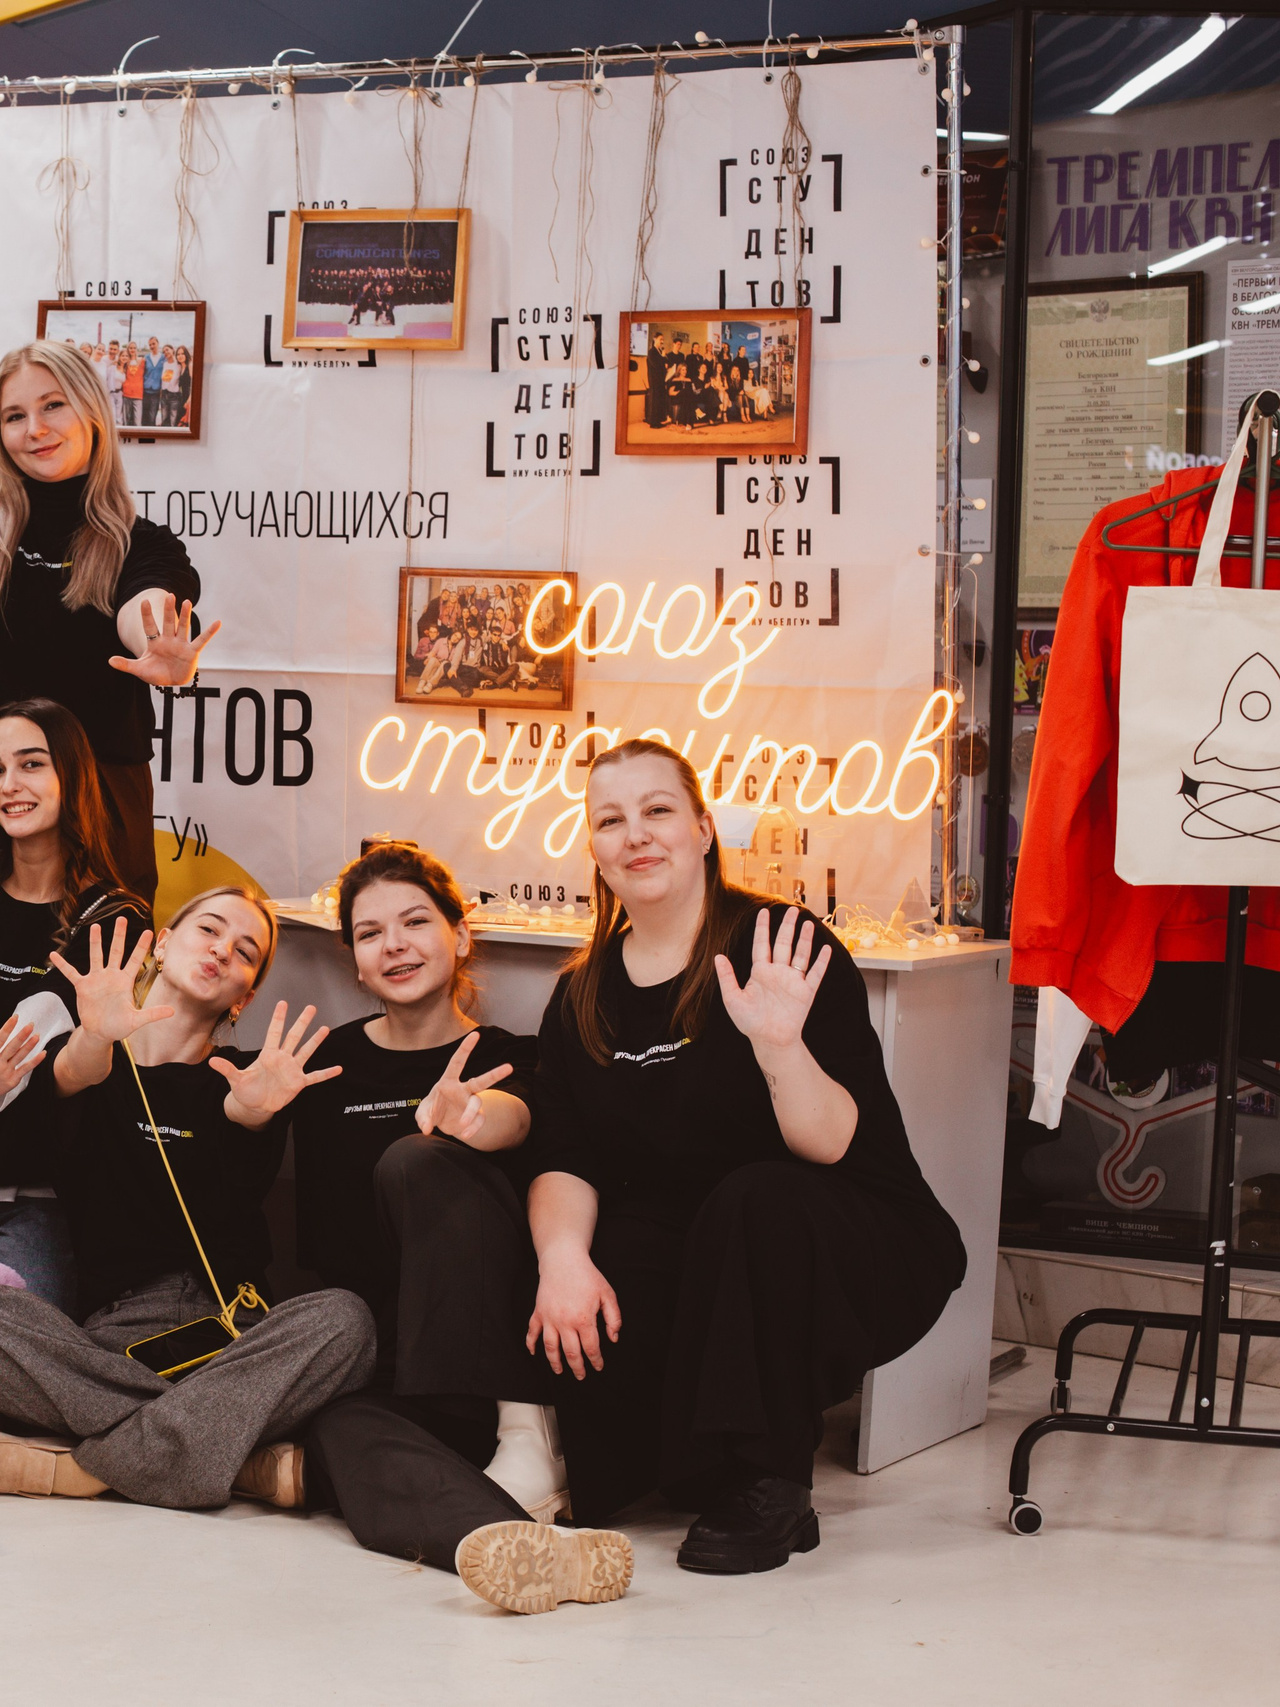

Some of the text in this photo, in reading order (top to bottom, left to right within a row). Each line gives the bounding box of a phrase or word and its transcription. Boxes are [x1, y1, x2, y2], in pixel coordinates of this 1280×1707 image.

[751, 147, 809, 165] СОЮЗ
[748, 175, 812, 204] СТУ
[1045, 193, 1275, 257] ЛИГА КВН
[744, 227, 814, 259] ДЕН
[85, 280, 132, 297] СОЮЗ
[746, 280, 812, 308] ТОВ
[519, 306, 573, 324] СОЮЗ
[1231, 320, 1250, 330] КВН
[517, 334, 573, 361] СТУ
[1059, 335, 1140, 349] СВИДЕТЕЛЬСТВО
[1065, 348, 1133, 360] О РОЖДЕНИИ
[514, 382, 575, 414] ДЕН
[1099, 385, 1117, 393] КВН
[514, 433, 571, 460] ТОВ
[746, 476, 810, 504] СТУ
[166, 490, 449, 544] ОБУЧАЮЩИХСЯ
[743, 529, 811, 559] ДЕН
[523, 577, 782, 720] союз
[153, 686, 314, 787] НТОВ
[510, 883, 565, 902] СОЮЗ
[1085, 1219, 1109, 1228] ВИЦЕ
[1117, 1221, 1160, 1232] ЧЕМПИОН
